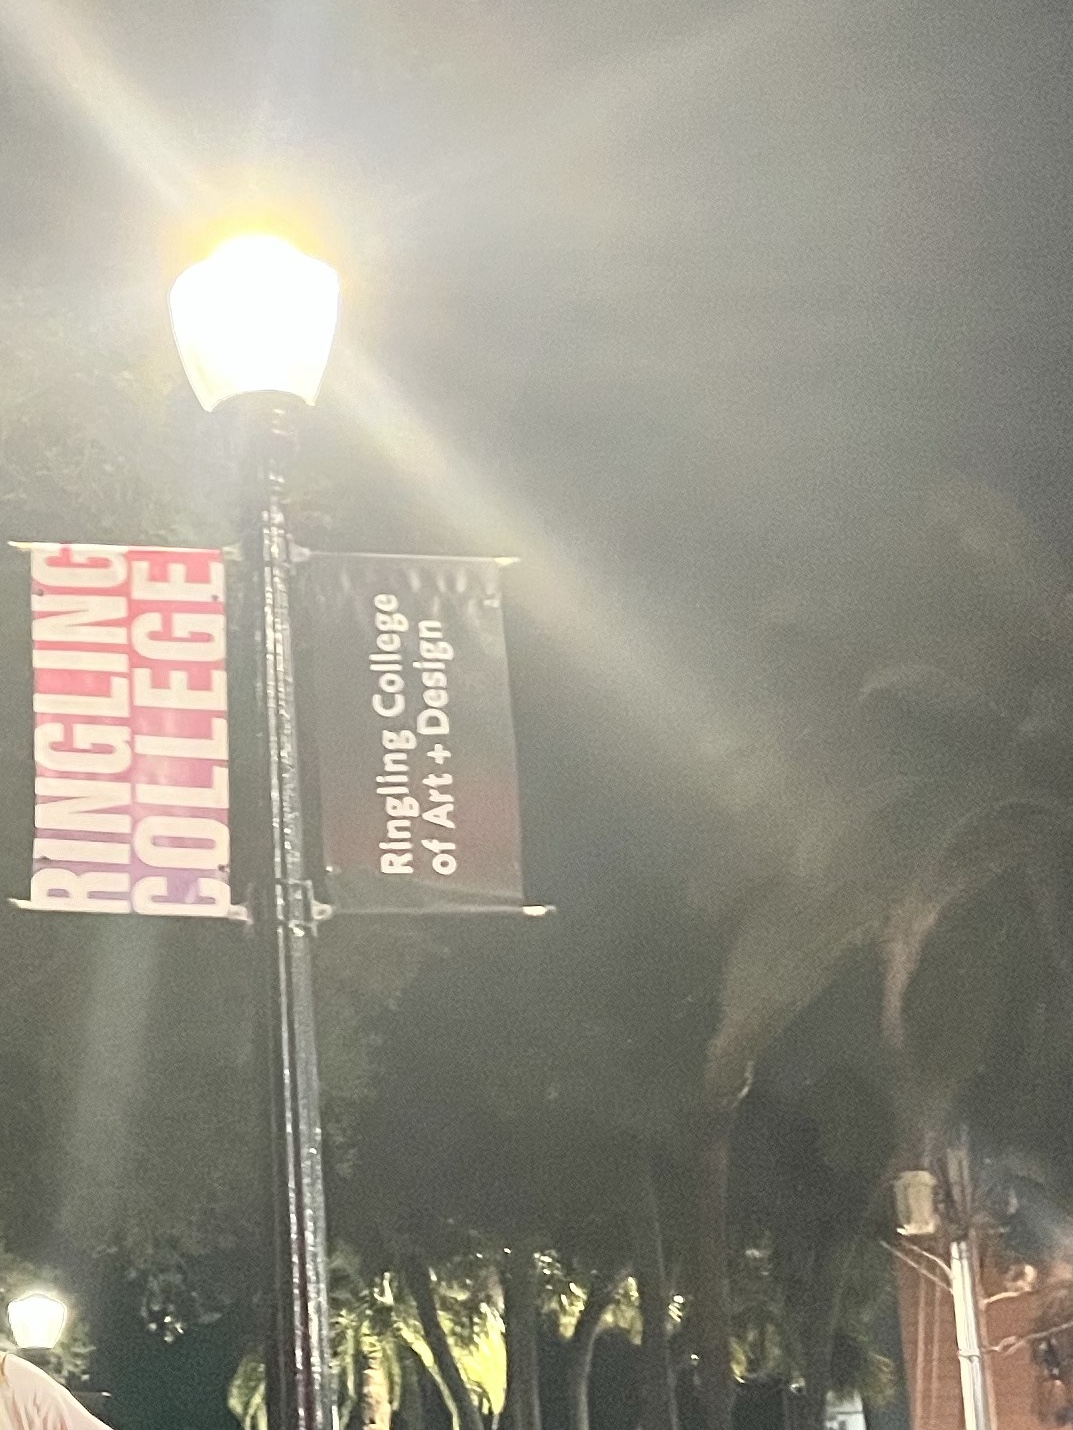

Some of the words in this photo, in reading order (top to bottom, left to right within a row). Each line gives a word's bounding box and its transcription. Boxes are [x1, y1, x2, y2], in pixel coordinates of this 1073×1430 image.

[369, 593, 409, 718] College
[412, 619, 454, 735] Design
[30, 546, 132, 913] RINGLING
[130, 560, 231, 916] COLLEGE
[427, 743, 452, 765] +
[376, 729, 420, 874] Ringling
[421, 773, 456, 829] Art
[421, 839, 457, 876] of
